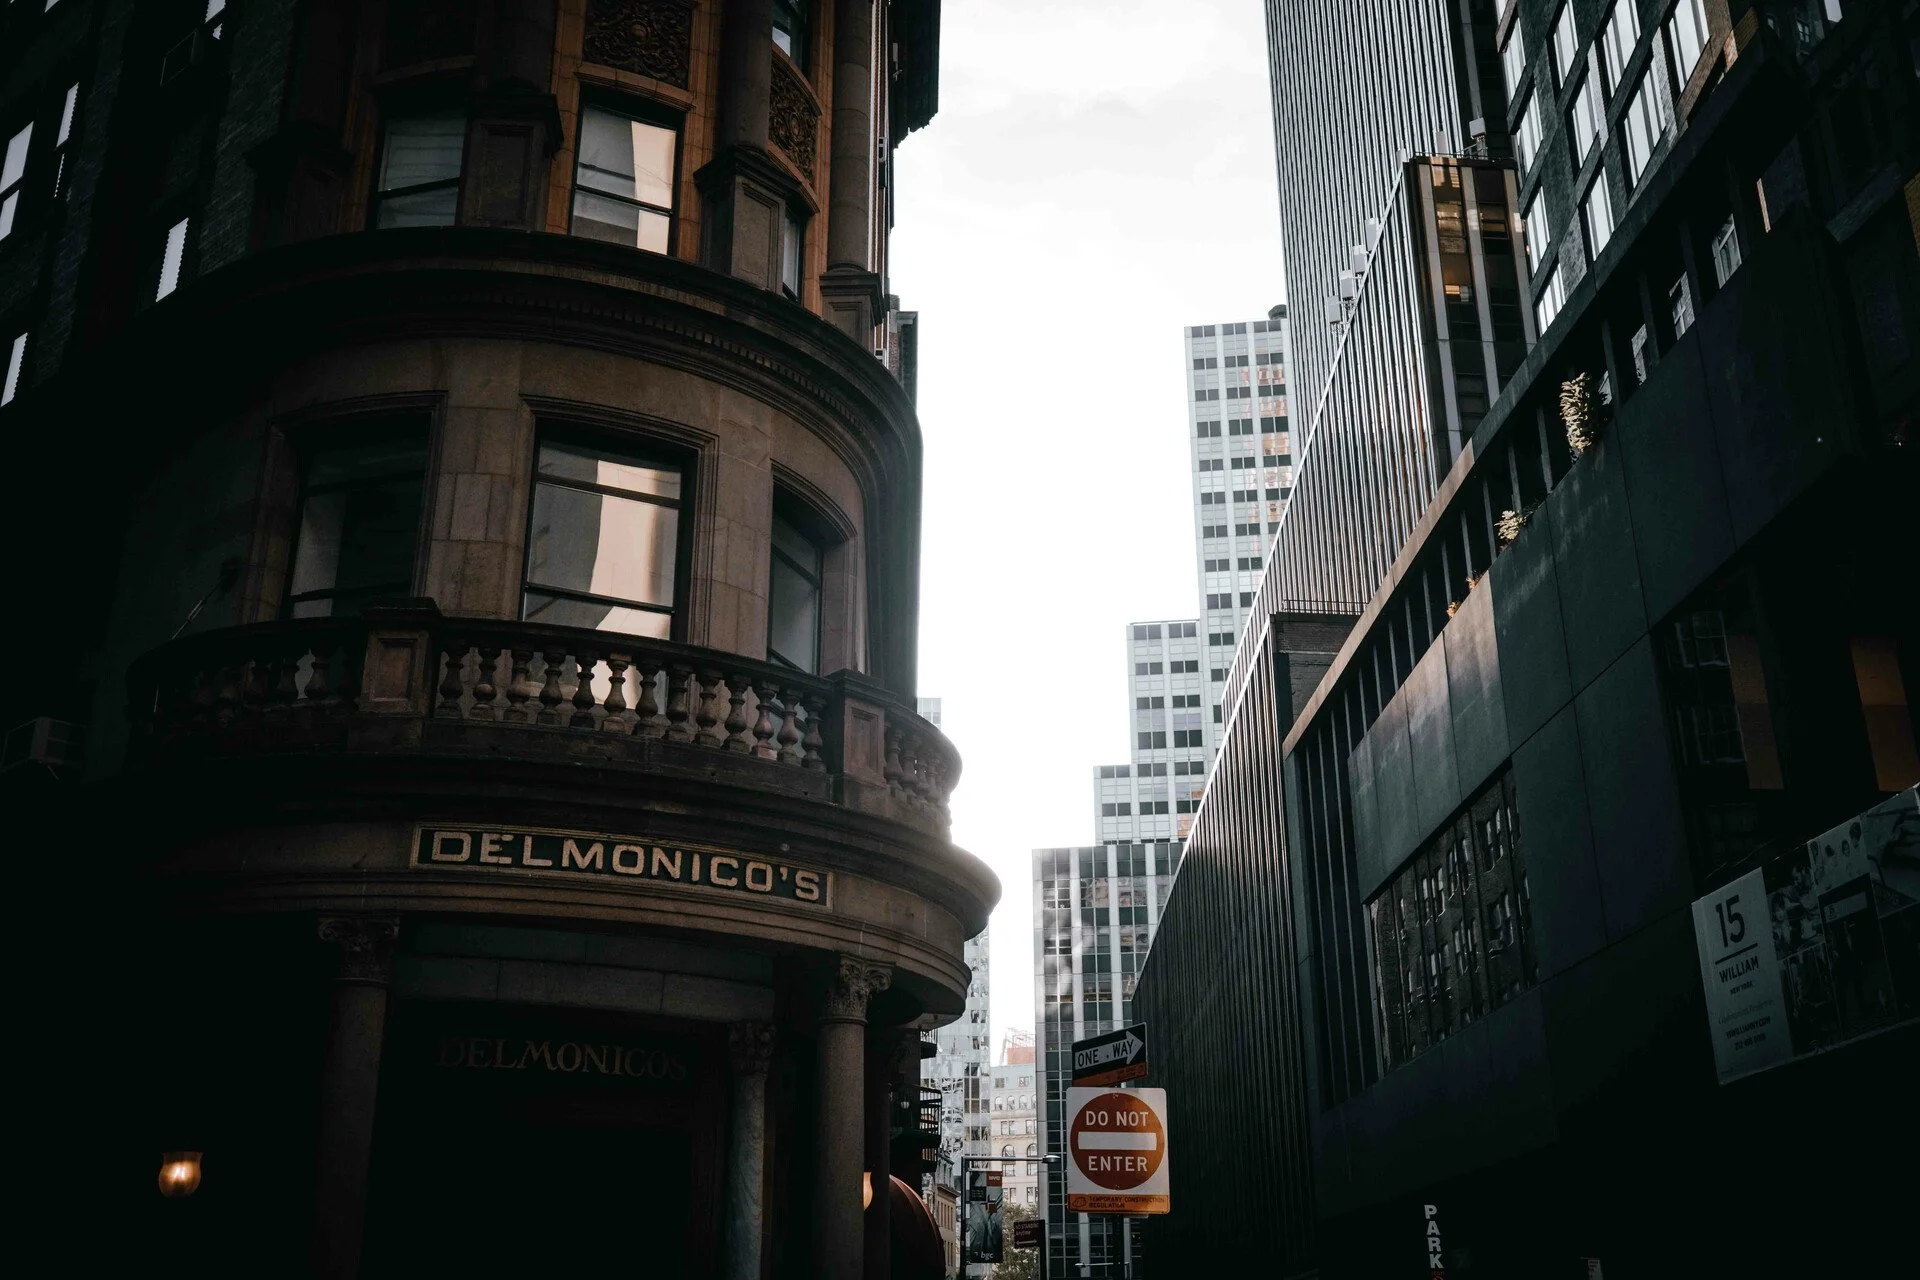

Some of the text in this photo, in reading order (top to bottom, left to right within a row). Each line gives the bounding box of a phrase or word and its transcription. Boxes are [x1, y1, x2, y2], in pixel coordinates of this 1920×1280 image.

[431, 830, 821, 901] DELMONICO'S
[1715, 894, 1745, 948] 15
[1719, 955, 1760, 983] WILLIAM
[1078, 1039, 1134, 1067] ONE WAY
[1085, 1110, 1148, 1126] DO NOT
[1088, 1156, 1148, 1172] ENTER
[1424, 1204, 1445, 1269] PARK
[981, 1251, 994, 1261] bgc
